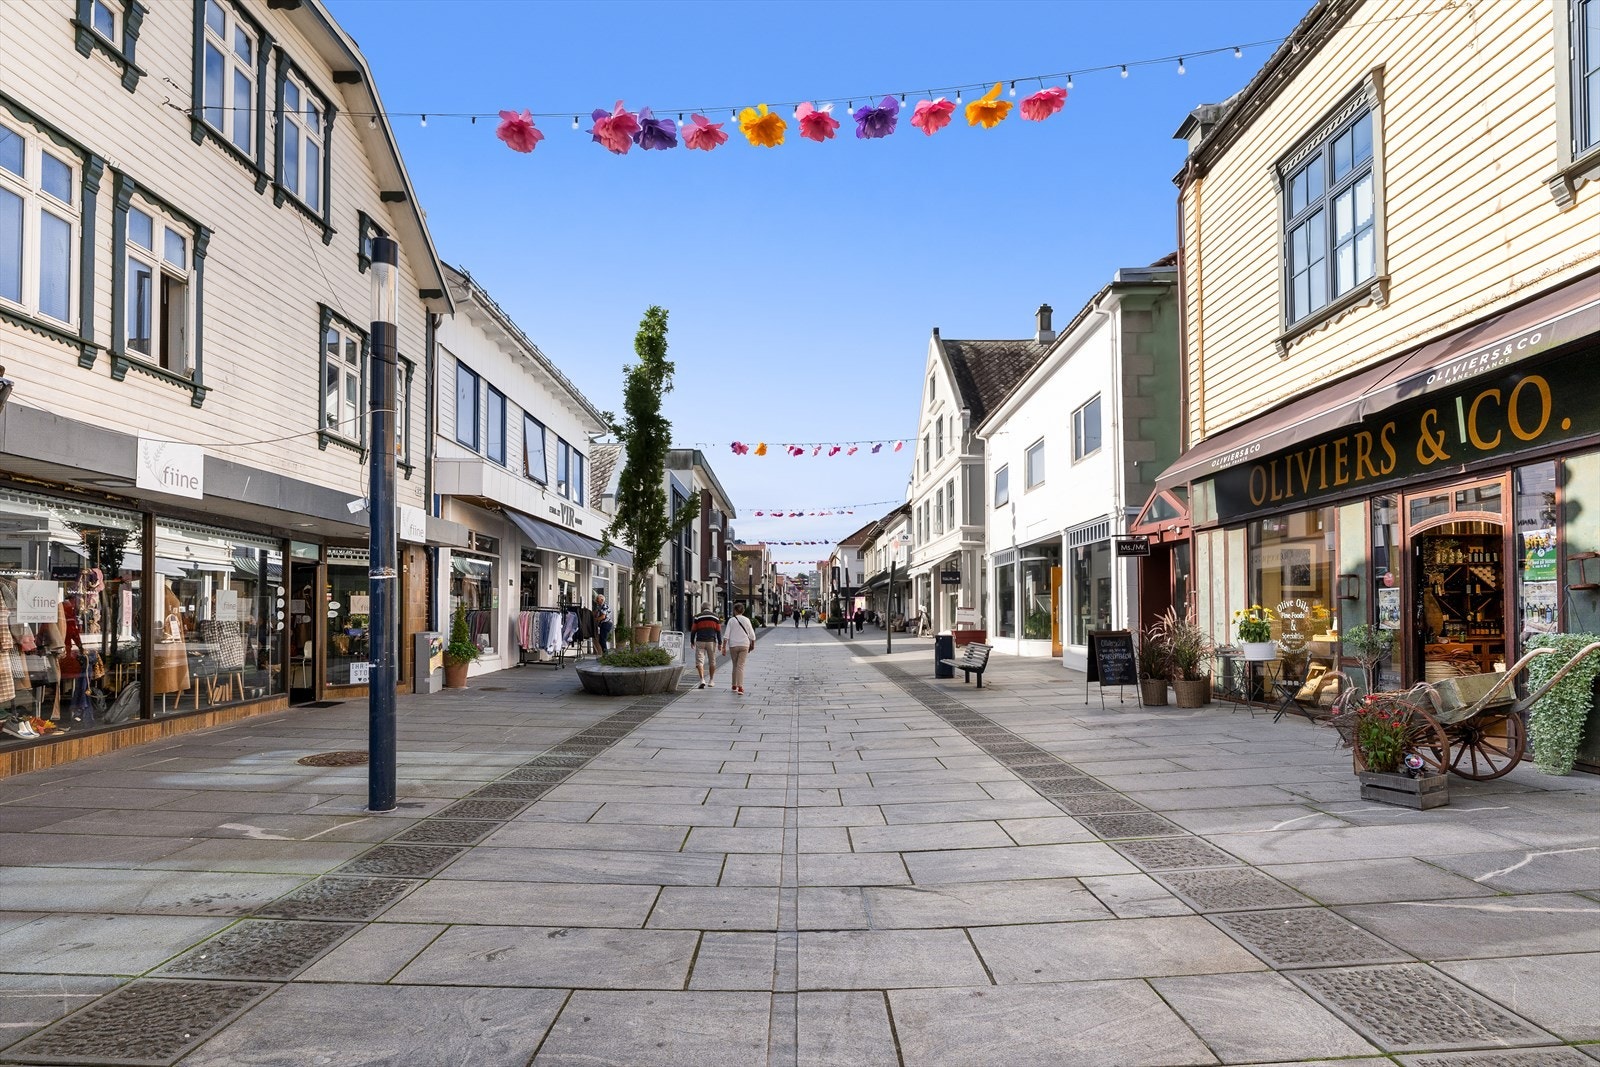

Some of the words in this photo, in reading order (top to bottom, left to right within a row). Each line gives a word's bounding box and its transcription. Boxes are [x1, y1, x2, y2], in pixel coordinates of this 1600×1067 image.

[1248, 420, 1397, 507] OLIVIERS
[1416, 408, 1451, 465] &
[1467, 375, 1571, 451] CO.
[163, 466, 200, 490] fiine
[410, 524, 424, 538] fiine
[33, 596, 56, 608] fiine
[1277, 600, 1294, 613] Olive
[1296, 599, 1309, 613] Oils
[1291, 611, 1305, 619] Foods
[1290, 619, 1297, 631] &
